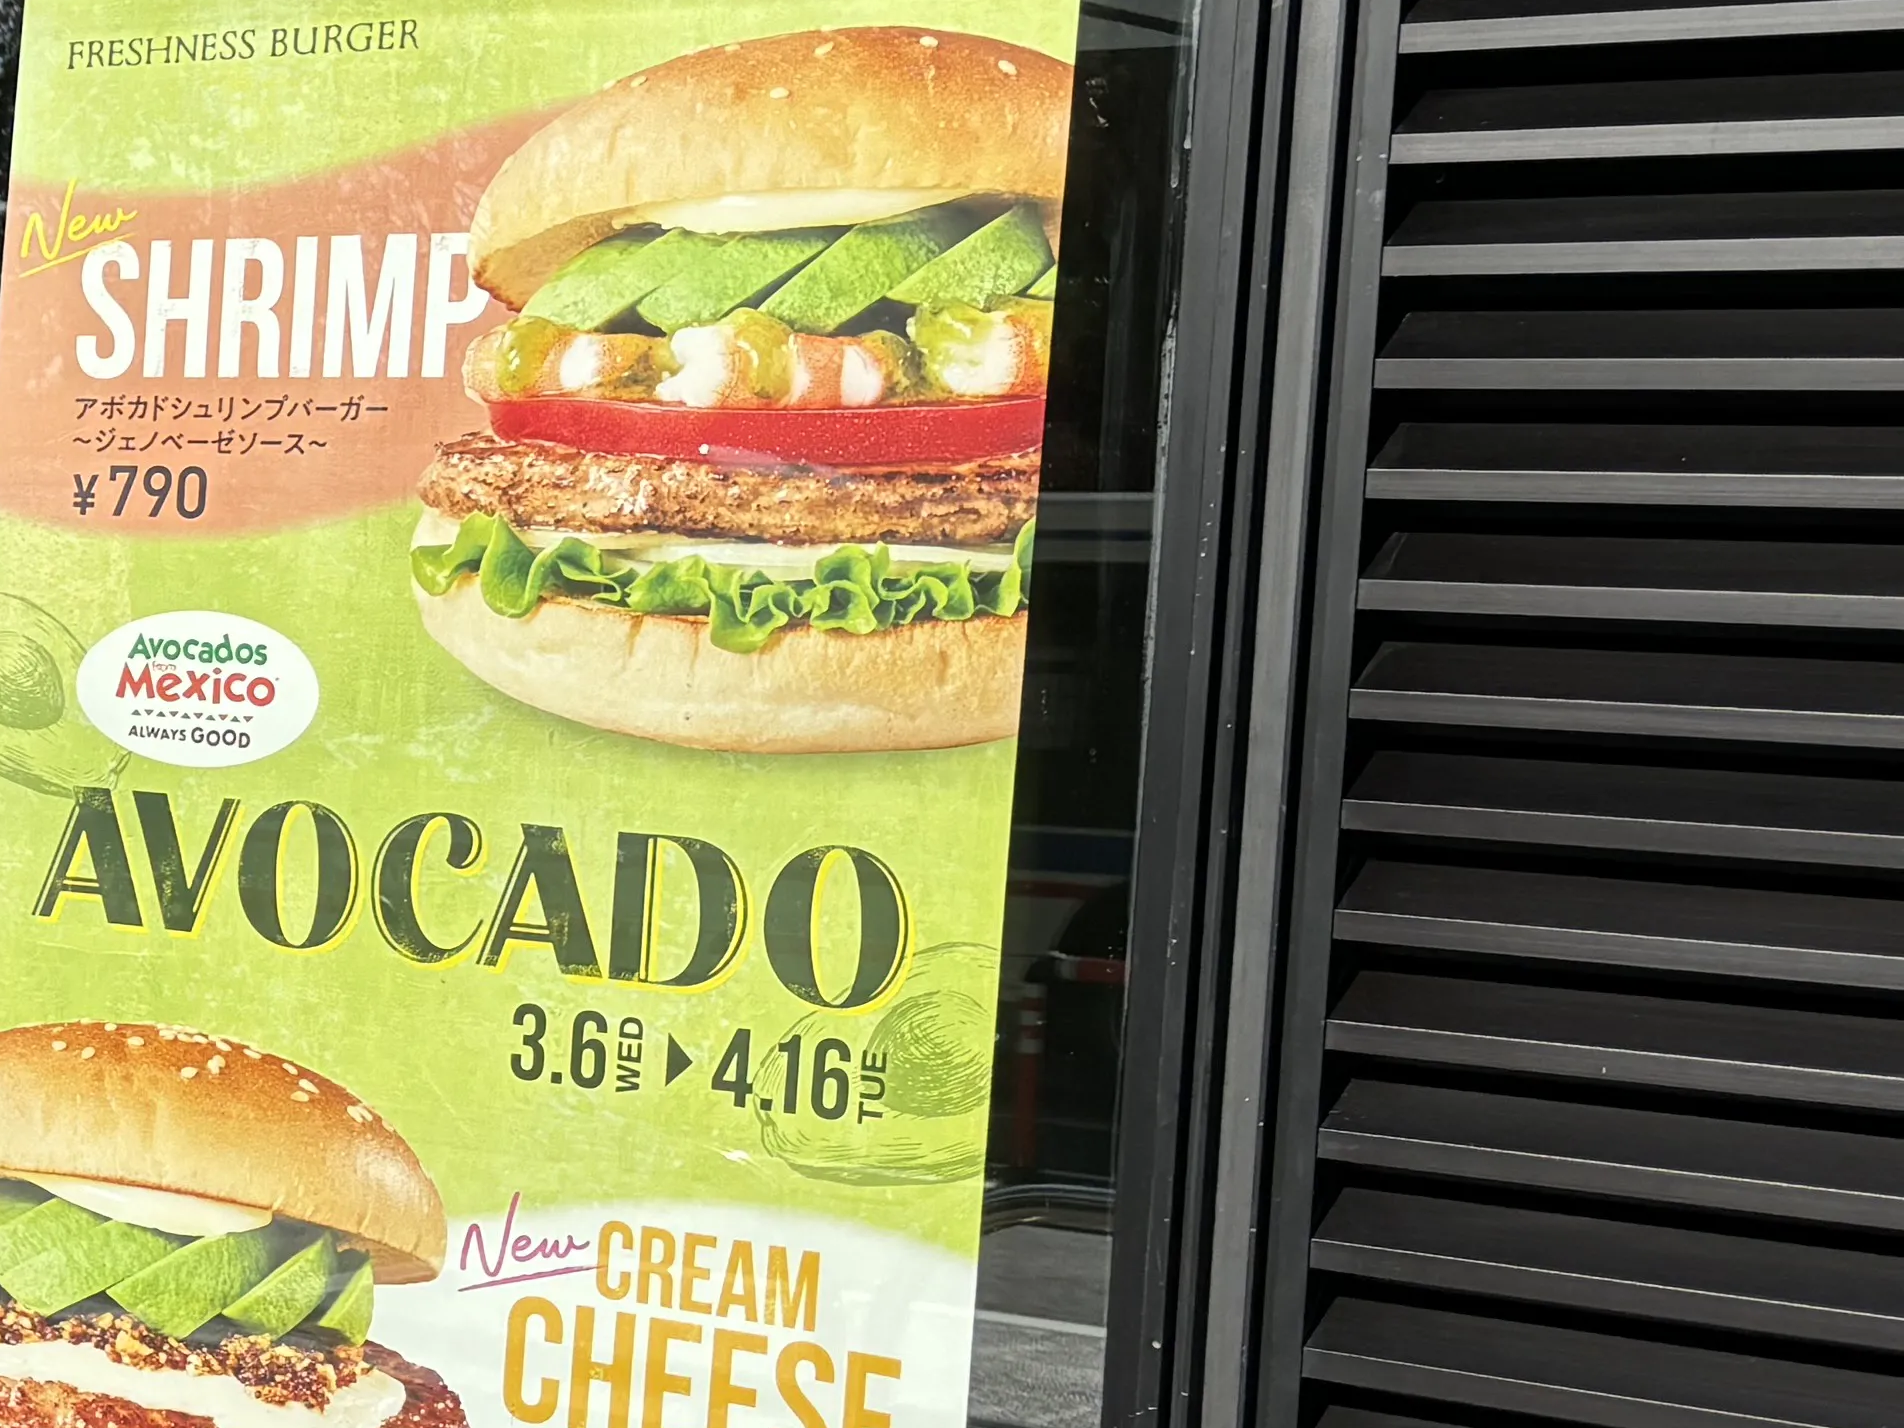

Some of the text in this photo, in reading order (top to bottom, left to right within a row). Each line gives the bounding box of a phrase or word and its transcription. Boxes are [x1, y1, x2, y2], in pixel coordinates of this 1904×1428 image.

[67, 19, 420, 70] FRESHNESS BURGER
[20, 178, 138, 262] New
[76, 232, 491, 380] SHRIMP
[74, 395, 389, 424] アボカドシュリンプバーガー
[72, 465, 208, 519] ¥790
[115, 661, 277, 707] Mexico
[128, 633, 268, 666] Avocados
[128, 725, 252, 749] ALWAYS GOOD
[31, 786, 916, 1015] AVOCADO
[509, 1003, 889, 1125] 3.6 WED 4.16 TUE
[460, 1192, 590, 1279] New
[596, 1220, 821, 1333] CREAM
